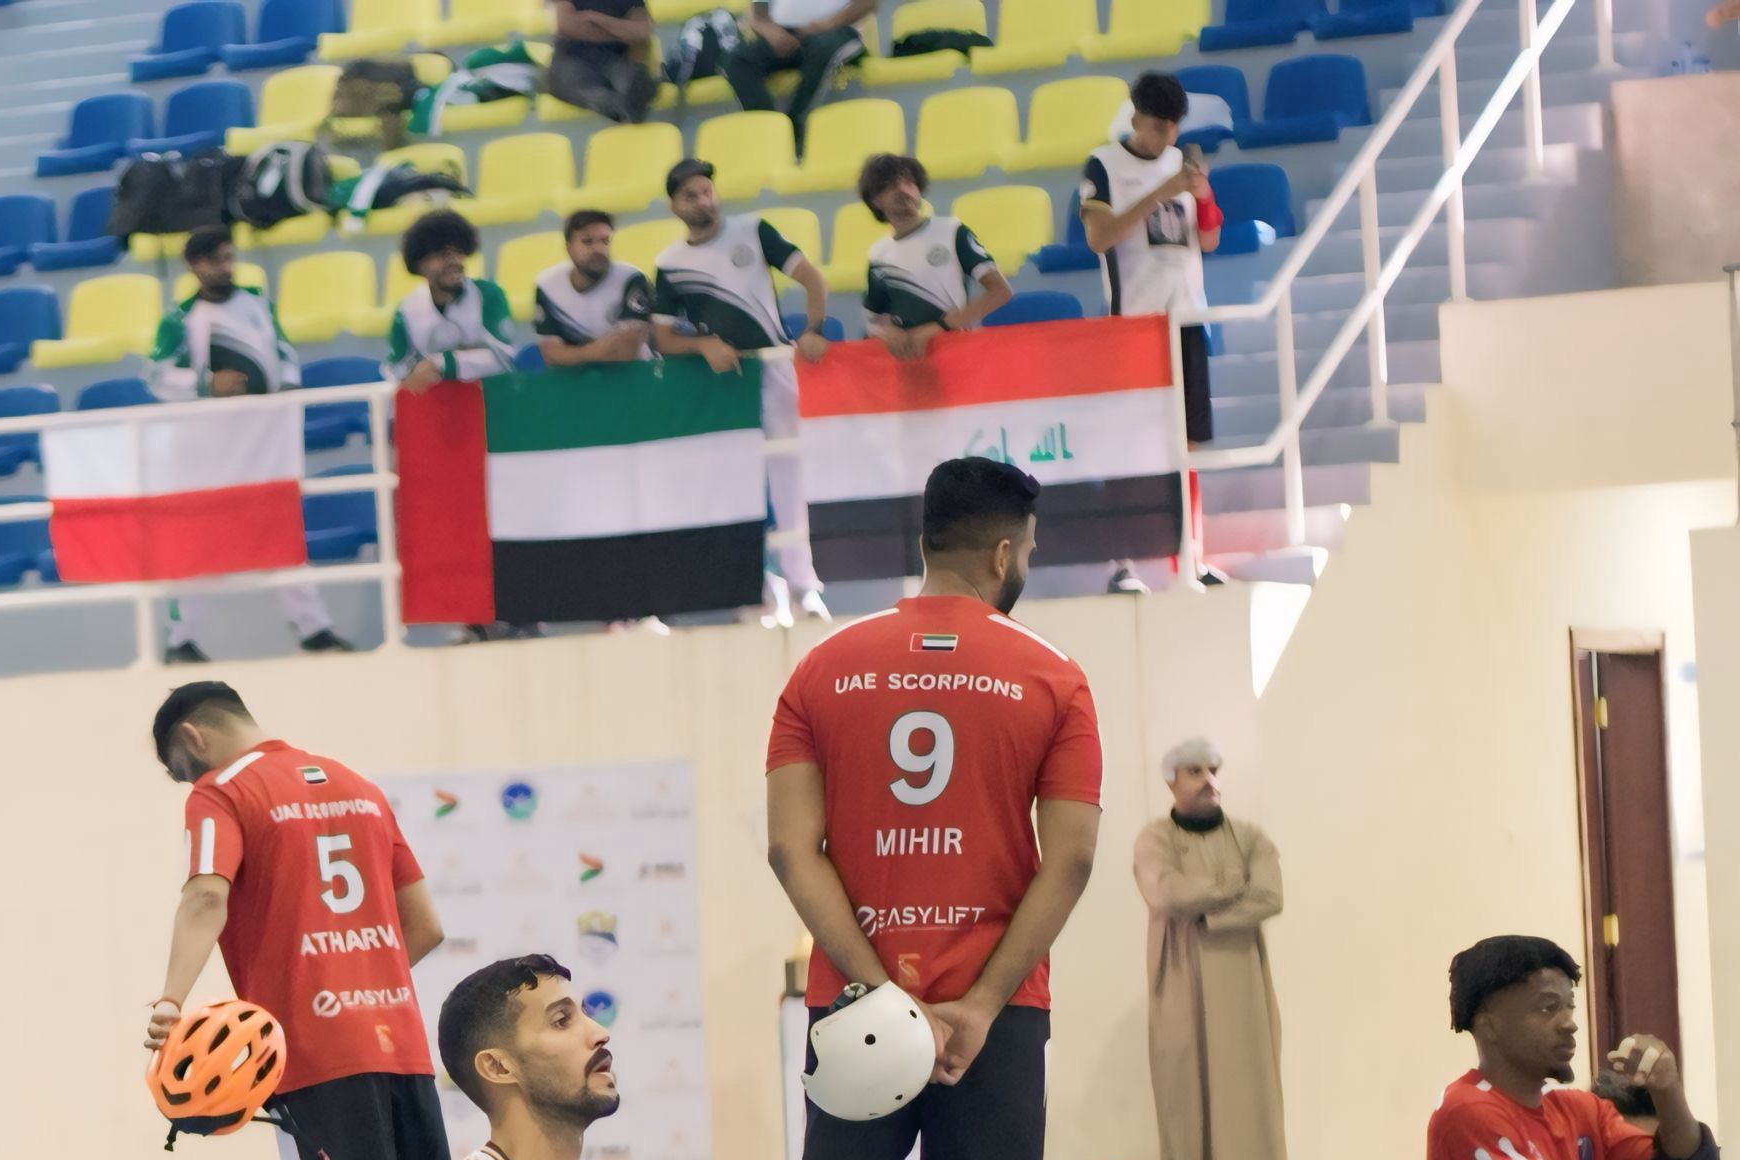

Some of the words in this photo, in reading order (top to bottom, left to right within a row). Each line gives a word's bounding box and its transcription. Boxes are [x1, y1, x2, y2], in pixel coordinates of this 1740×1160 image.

[834, 673, 877, 694] UAE
[888, 673, 1024, 701] SCORPIONS
[889, 711, 955, 806] 9
[875, 827, 963, 857] MIHIR
[316, 833, 365, 914] 5
